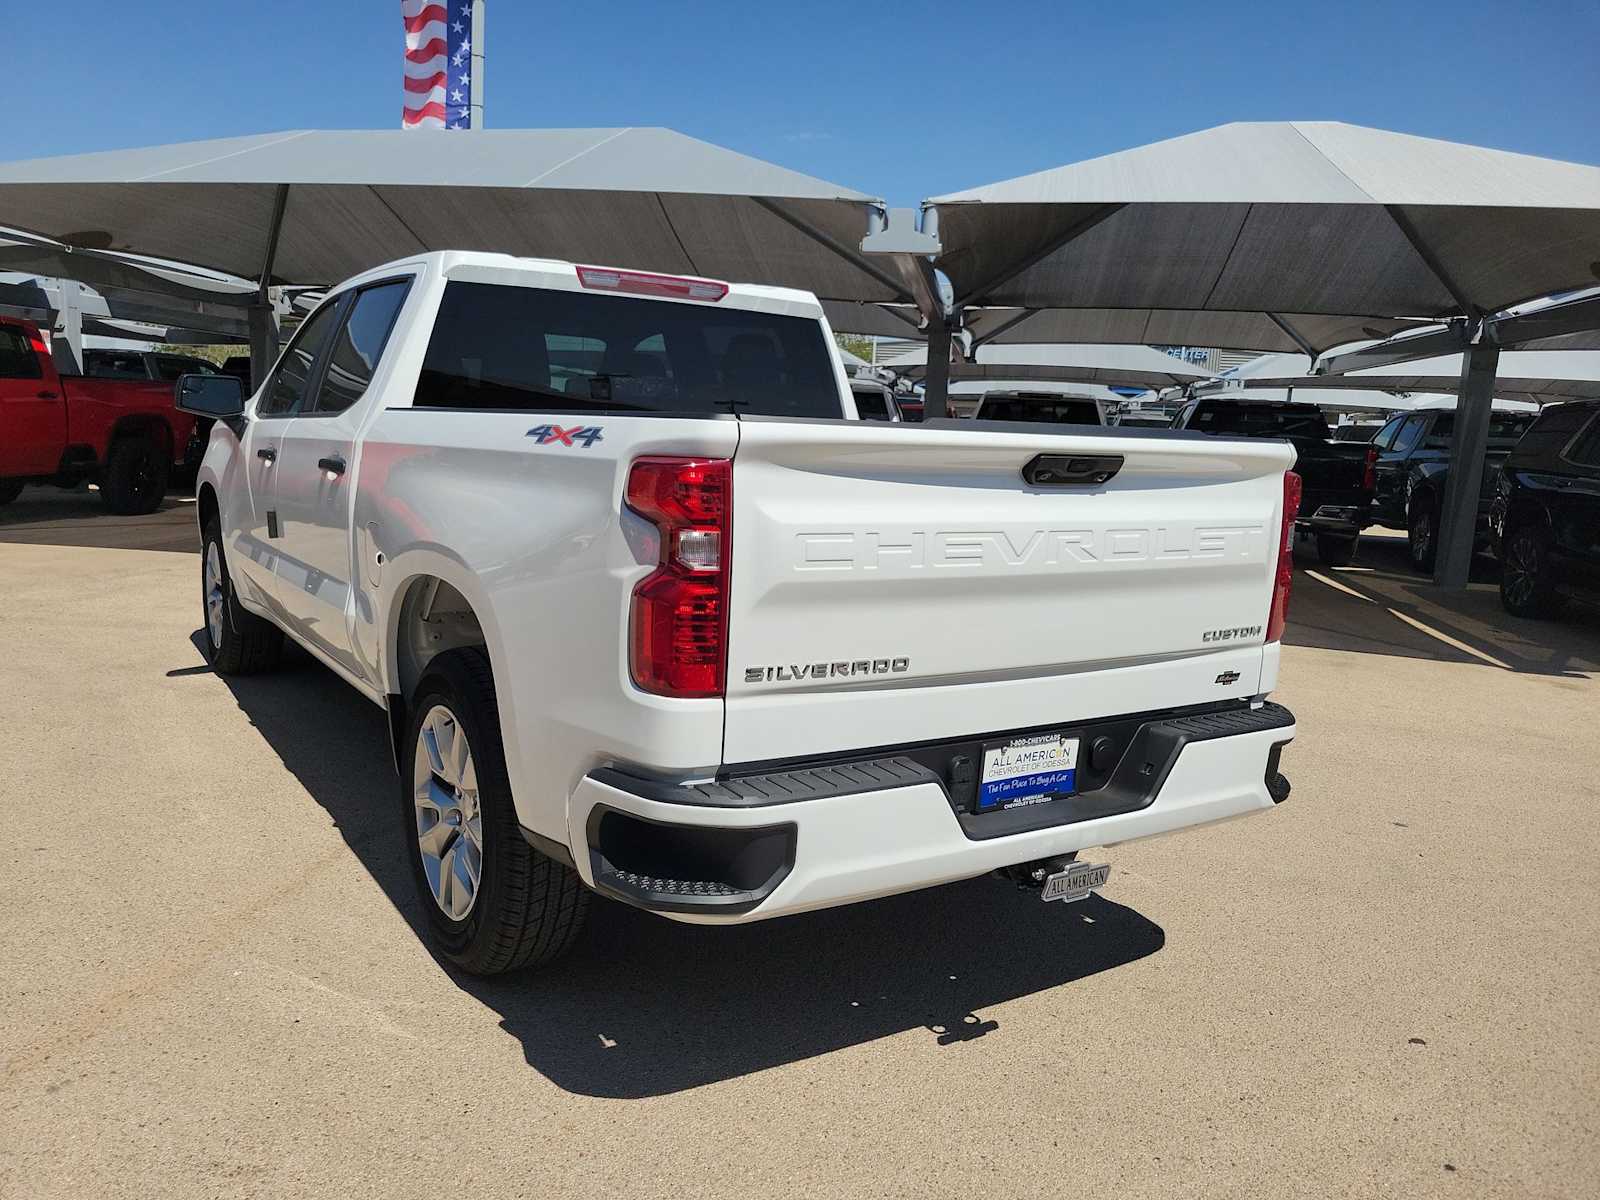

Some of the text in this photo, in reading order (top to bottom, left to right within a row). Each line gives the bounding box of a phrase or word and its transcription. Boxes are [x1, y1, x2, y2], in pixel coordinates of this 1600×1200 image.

[794, 526, 1263, 570] CHEVROLET
[1203, 626, 1262, 642] CUSTOM
[744, 656, 910, 683] SILVERADO
[988, 764, 1029, 777] CHEVROLET
[1042, 758, 1071, 768] ODESSA
[992, 756, 1011, 767] ALL
[987, 784, 999, 794] The
[1029, 776, 1036, 786] To
[1049, 774, 1056, 783] A
[1050, 870, 1105, 894] ALL AMERICAN
